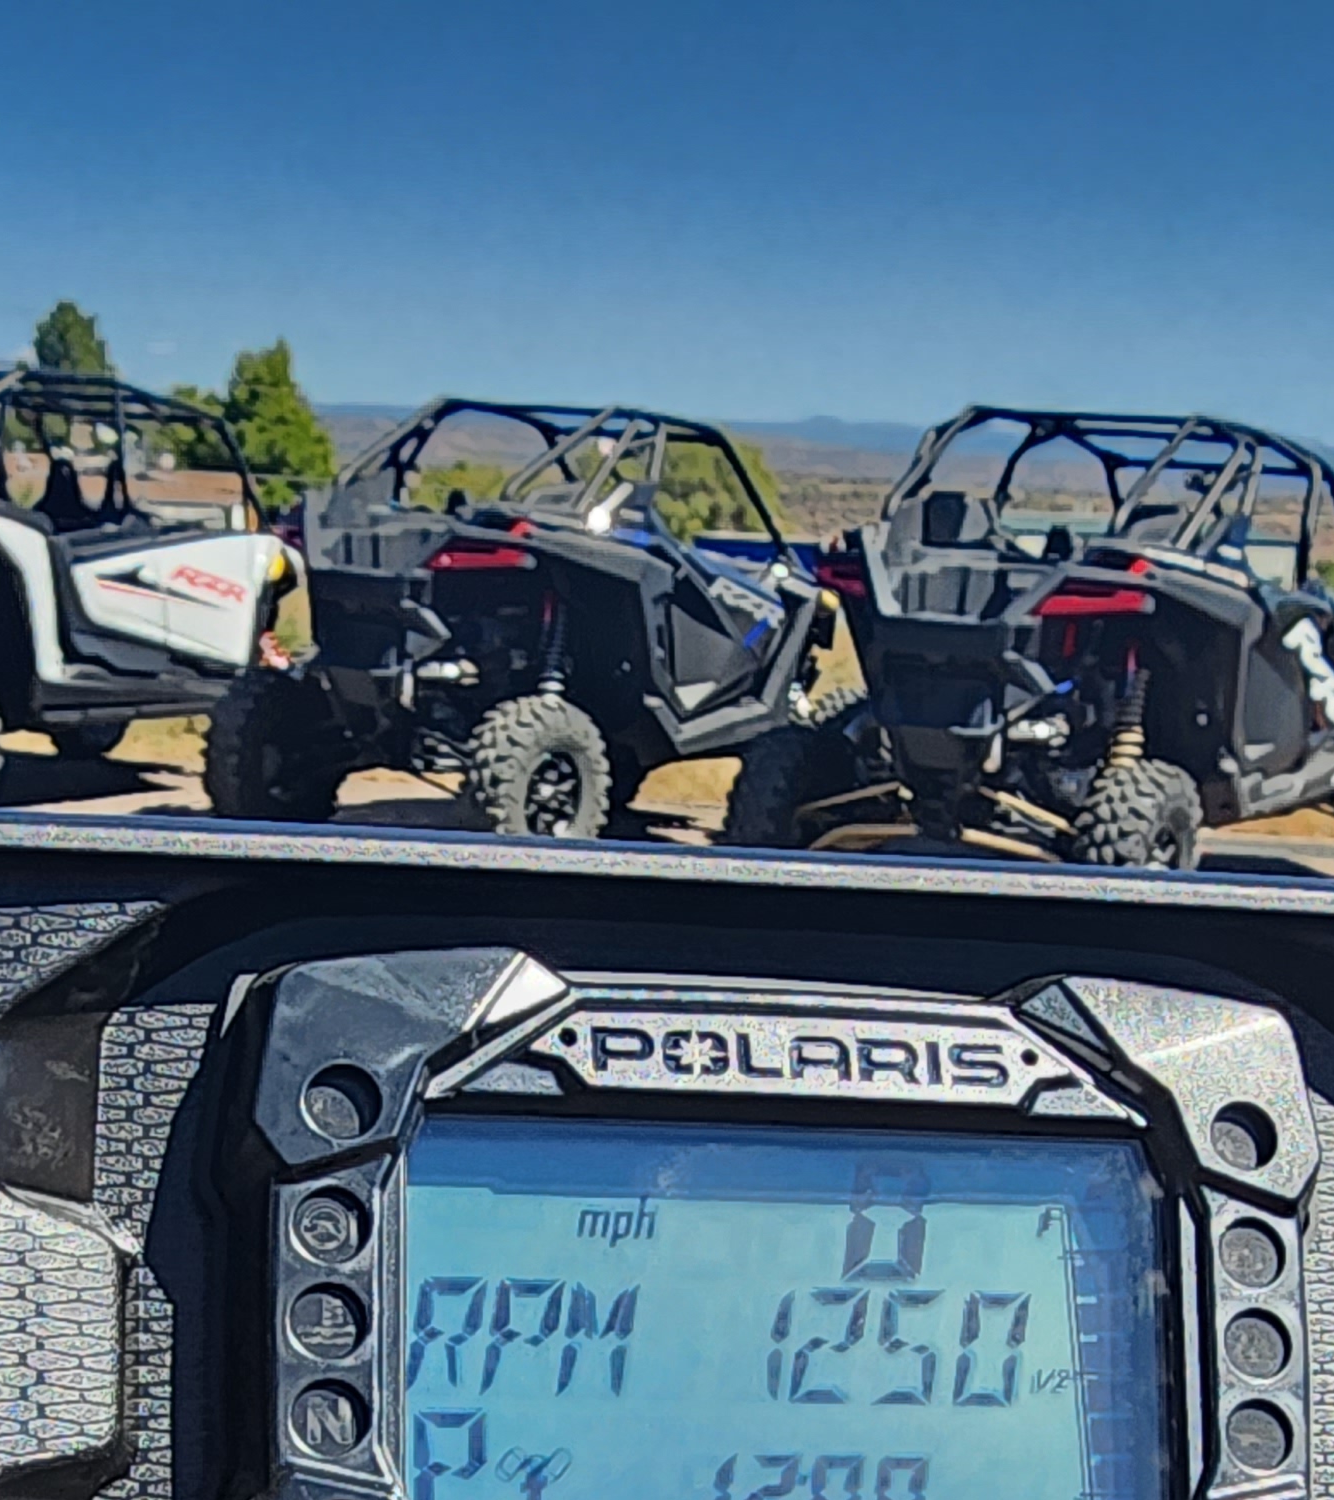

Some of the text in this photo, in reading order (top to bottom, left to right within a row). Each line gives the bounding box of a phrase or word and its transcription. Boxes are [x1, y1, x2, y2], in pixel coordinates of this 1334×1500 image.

[590, 1025, 1010, 1088] POLARIS
[577, 1194, 657, 1248] mph
[407, 1275, 1032, 1407] RPM 1250
